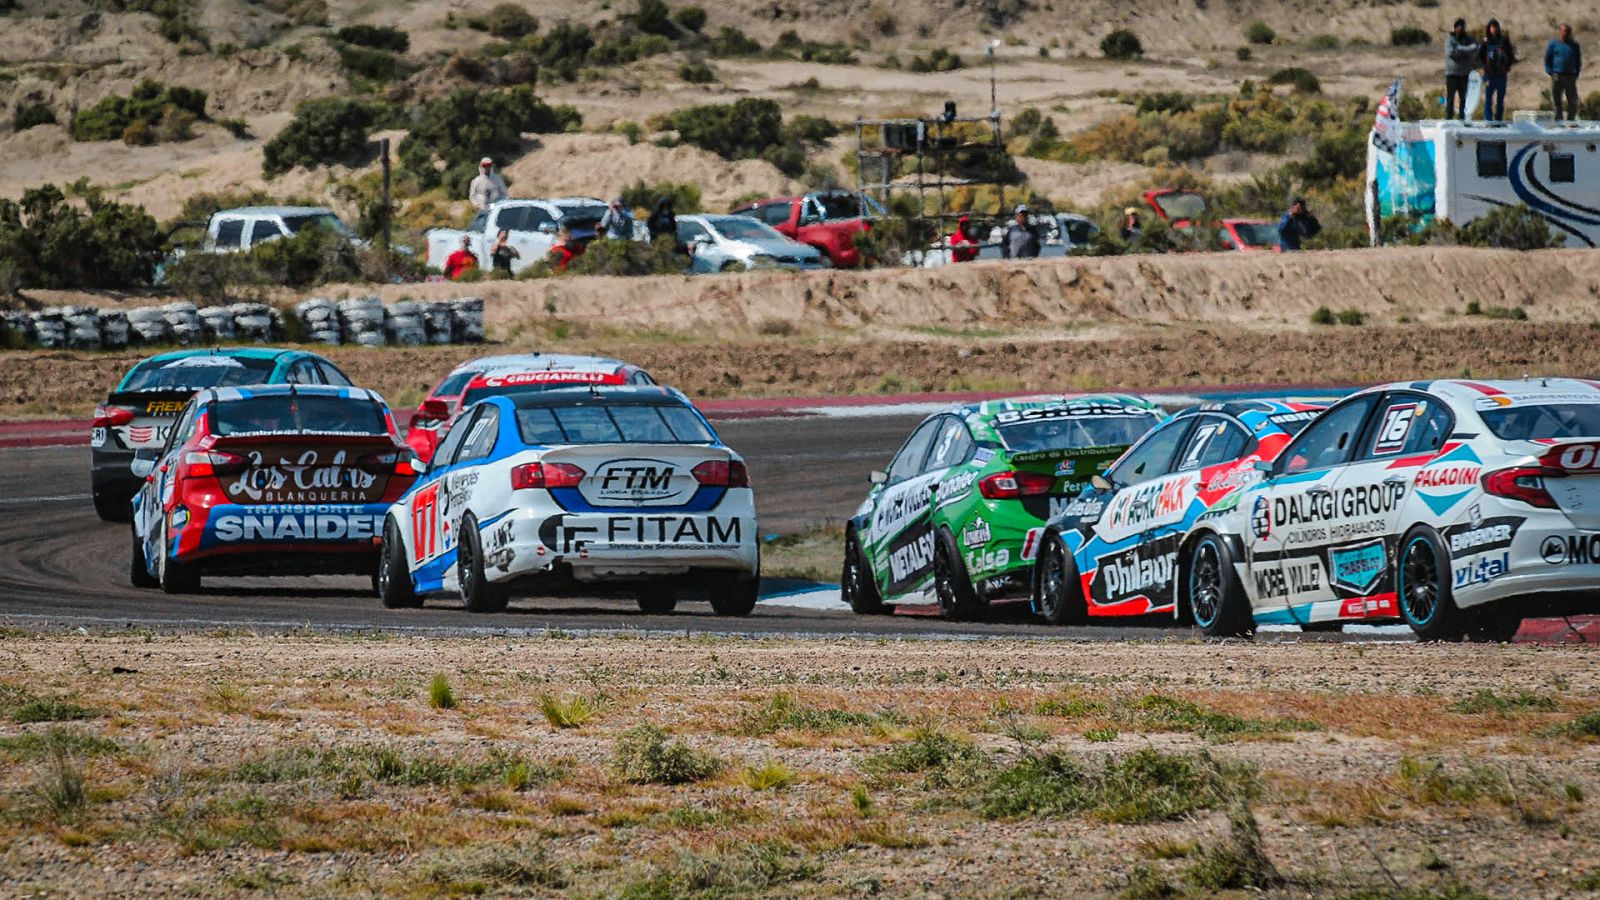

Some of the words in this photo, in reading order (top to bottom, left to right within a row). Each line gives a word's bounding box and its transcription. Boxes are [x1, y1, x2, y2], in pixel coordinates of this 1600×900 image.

[1379, 408, 1414, 442] 16
[1186, 427, 1216, 461] 7
[229, 450, 287, 501] Los
[601, 466, 675, 491] FTM
[1414, 466, 1482, 489] PALADINI
[243, 504, 365, 515] TRANSPORTE
[265, 490, 367, 502] BLANQUERIA
[1274, 489, 1338, 527] DALAGI
[1341, 480, 1406, 518] GROUP
[606, 515, 742, 544] FITAM
